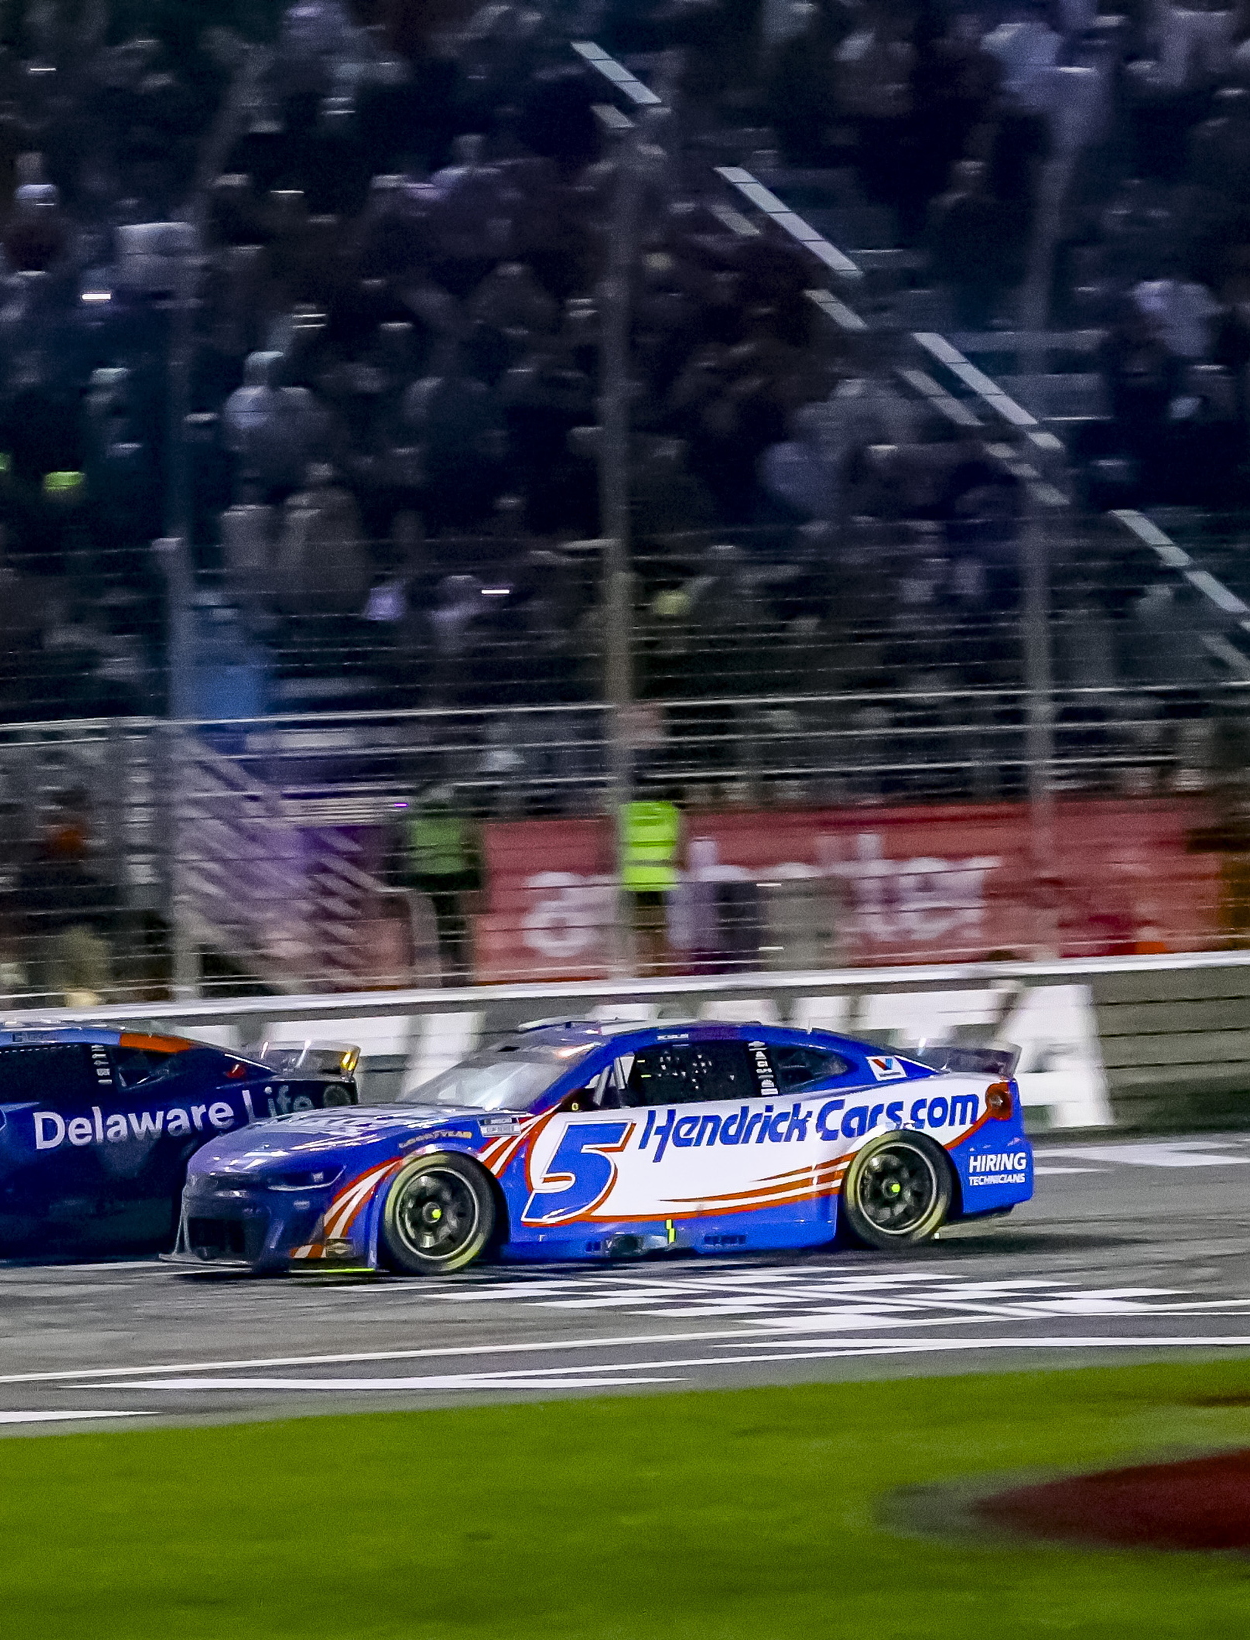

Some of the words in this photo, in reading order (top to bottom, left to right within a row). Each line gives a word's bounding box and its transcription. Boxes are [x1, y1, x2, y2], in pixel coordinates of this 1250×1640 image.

[33, 1101, 234, 1149] Delaware
[638, 1093, 979, 1163] HendrickCars.com
[523, 1120, 636, 1224] 5
[968, 1152, 1027, 1174] HIRING
[968, 1173, 1026, 1187] TECHNICIANS
